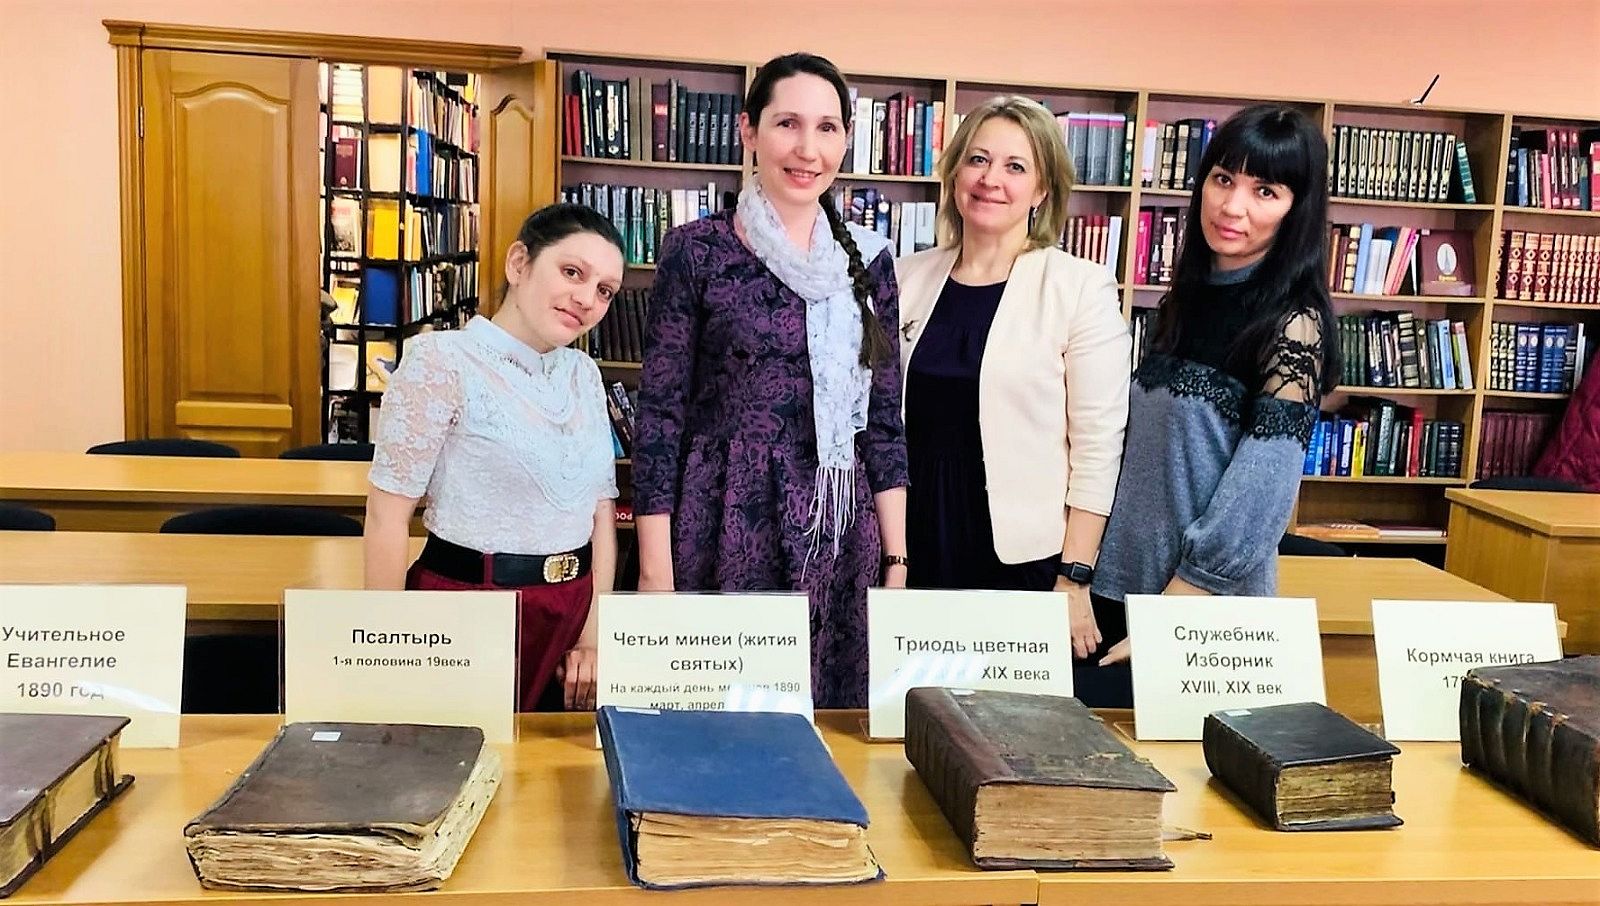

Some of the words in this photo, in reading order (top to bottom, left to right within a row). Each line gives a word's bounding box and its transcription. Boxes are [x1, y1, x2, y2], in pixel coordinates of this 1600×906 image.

[2, 626, 126, 642] Учительное
[352, 628, 452, 649] Псалтырь
[613, 631, 669, 648] Четьи
[675, 635, 732, 648] минеи
[738, 631, 797, 650] (жития
[1174, 625, 1280, 645] Служебник.
[894, 635, 967, 656] Триодь
[972, 640, 1049, 656] цветная
[6, 652, 117, 669] Евангелие
[333, 655, 353, 667] 1-я
[356, 655, 422, 667] половина
[426, 655, 471, 668] 19века
[670, 656, 744, 675] святых)
[1185, 651, 1274, 671] Изборник
[1406, 647, 1482, 668] Кормчая
[1489, 652, 1535, 668] книга
[980, 665, 1008, 680] XIX
[1013, 669, 1051, 681] века
[17, 681, 63, 700] 1890
[610, 682, 627, 694] На
[630, 682, 680, 696] каждый
[682, 684, 715, 696] день
[774, 681, 801, 694] 1890
[1226, 679, 1252, 695] XIX
[1257, 683, 1283, 695] век
[1443, 675, 1464, 691] 17
[687, 700, 728, 713] апрел
